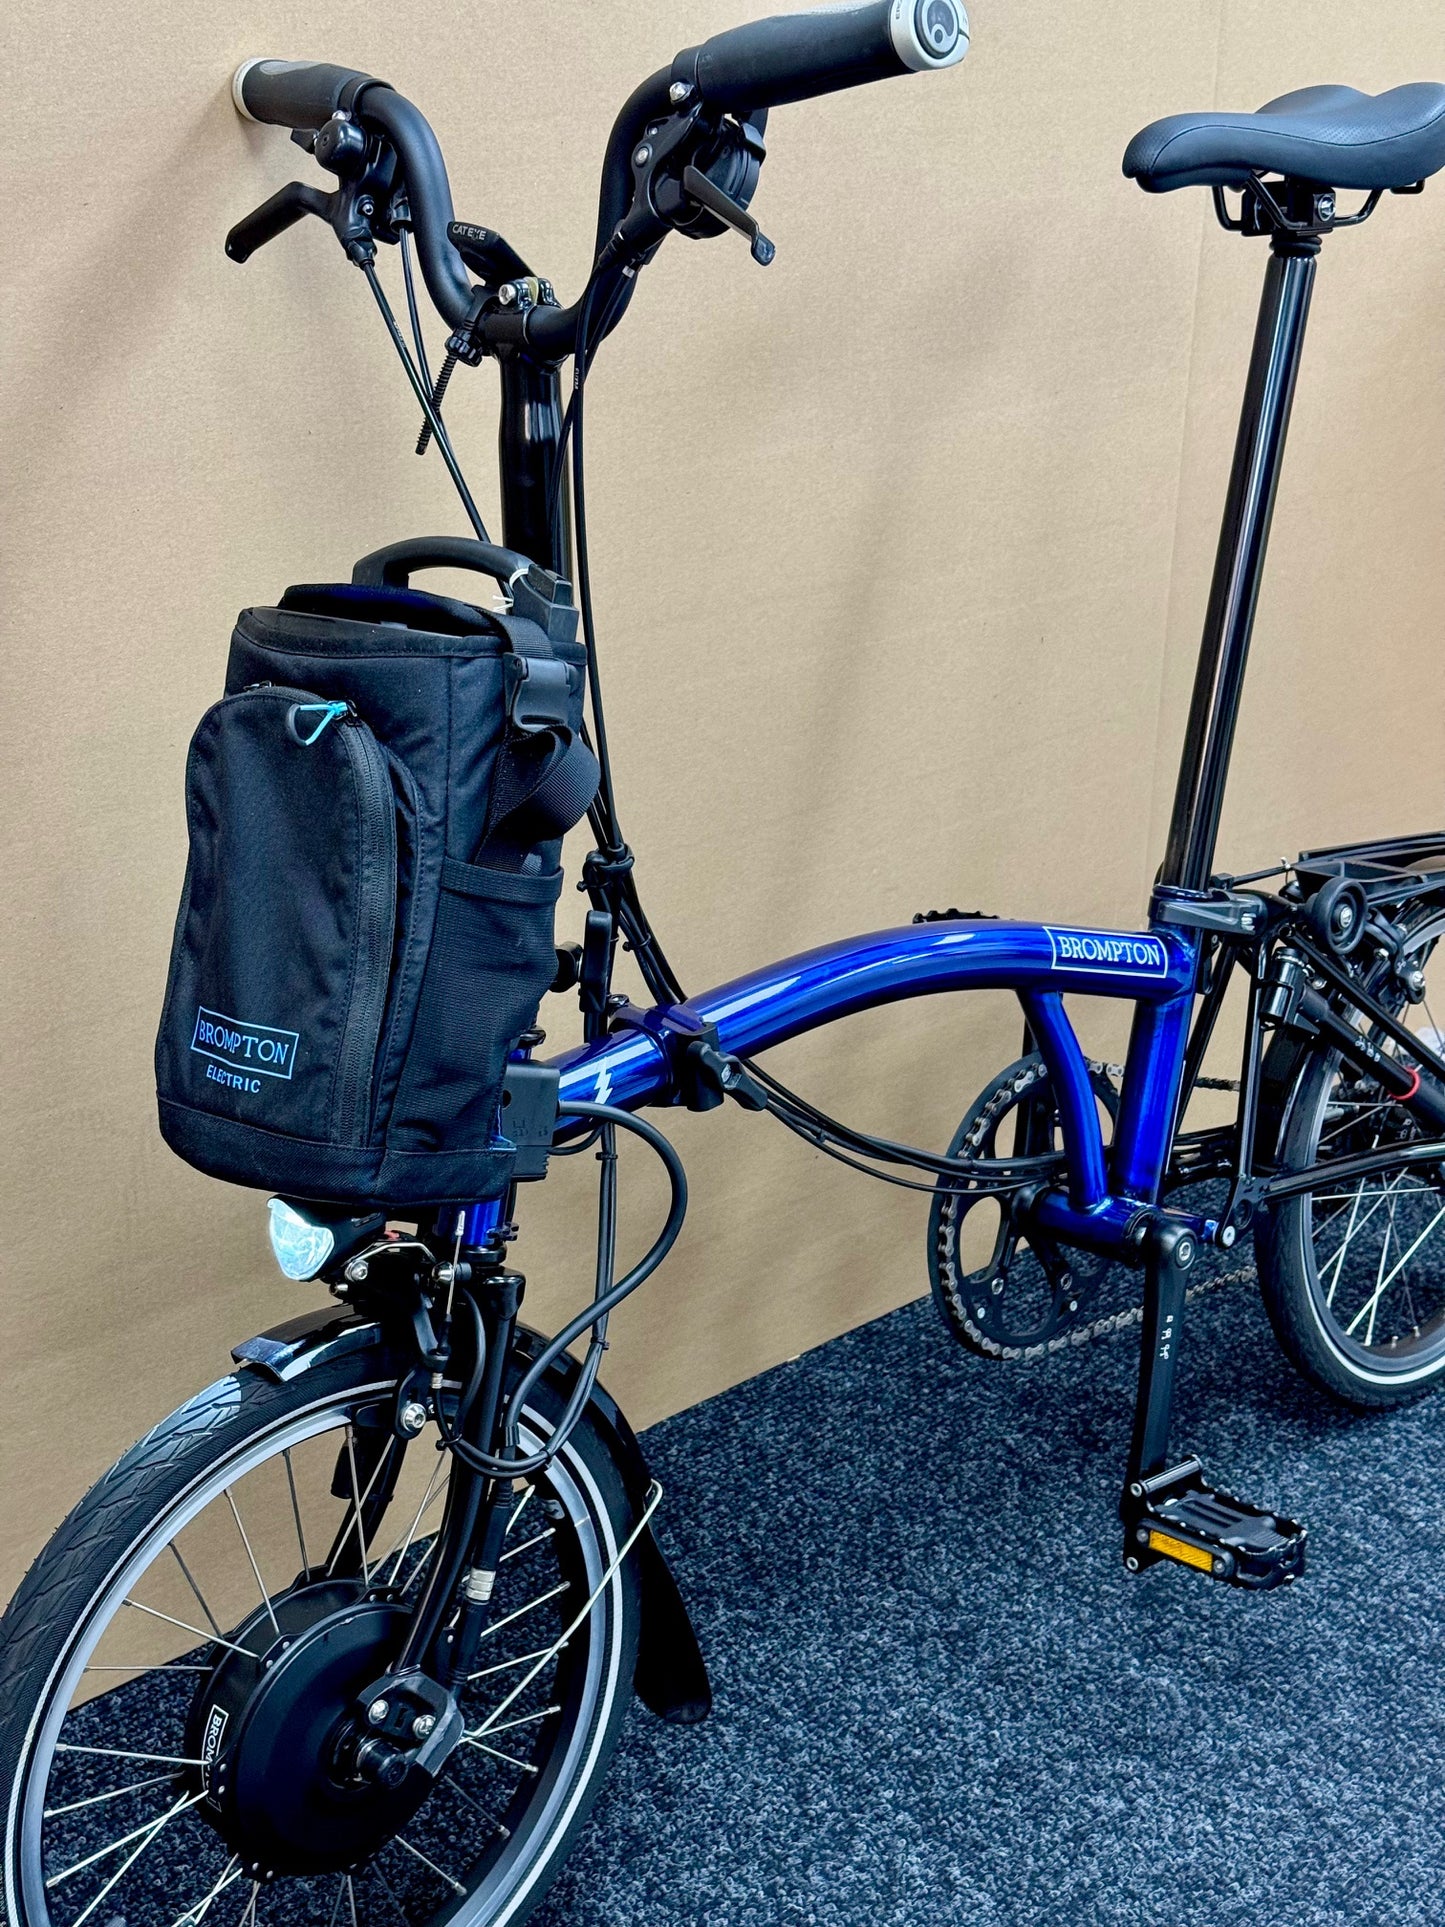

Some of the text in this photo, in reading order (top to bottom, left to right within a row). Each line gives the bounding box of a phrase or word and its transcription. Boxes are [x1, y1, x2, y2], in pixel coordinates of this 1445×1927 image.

[452, 224, 487, 241] CATEYE
[1057, 936, 1160, 966] BROMPTON
[199, 1019, 290, 1065] BROMPTON
[206, 1064, 261, 1093] ELECTRIC
[205, 1714, 223, 1789] BROM
